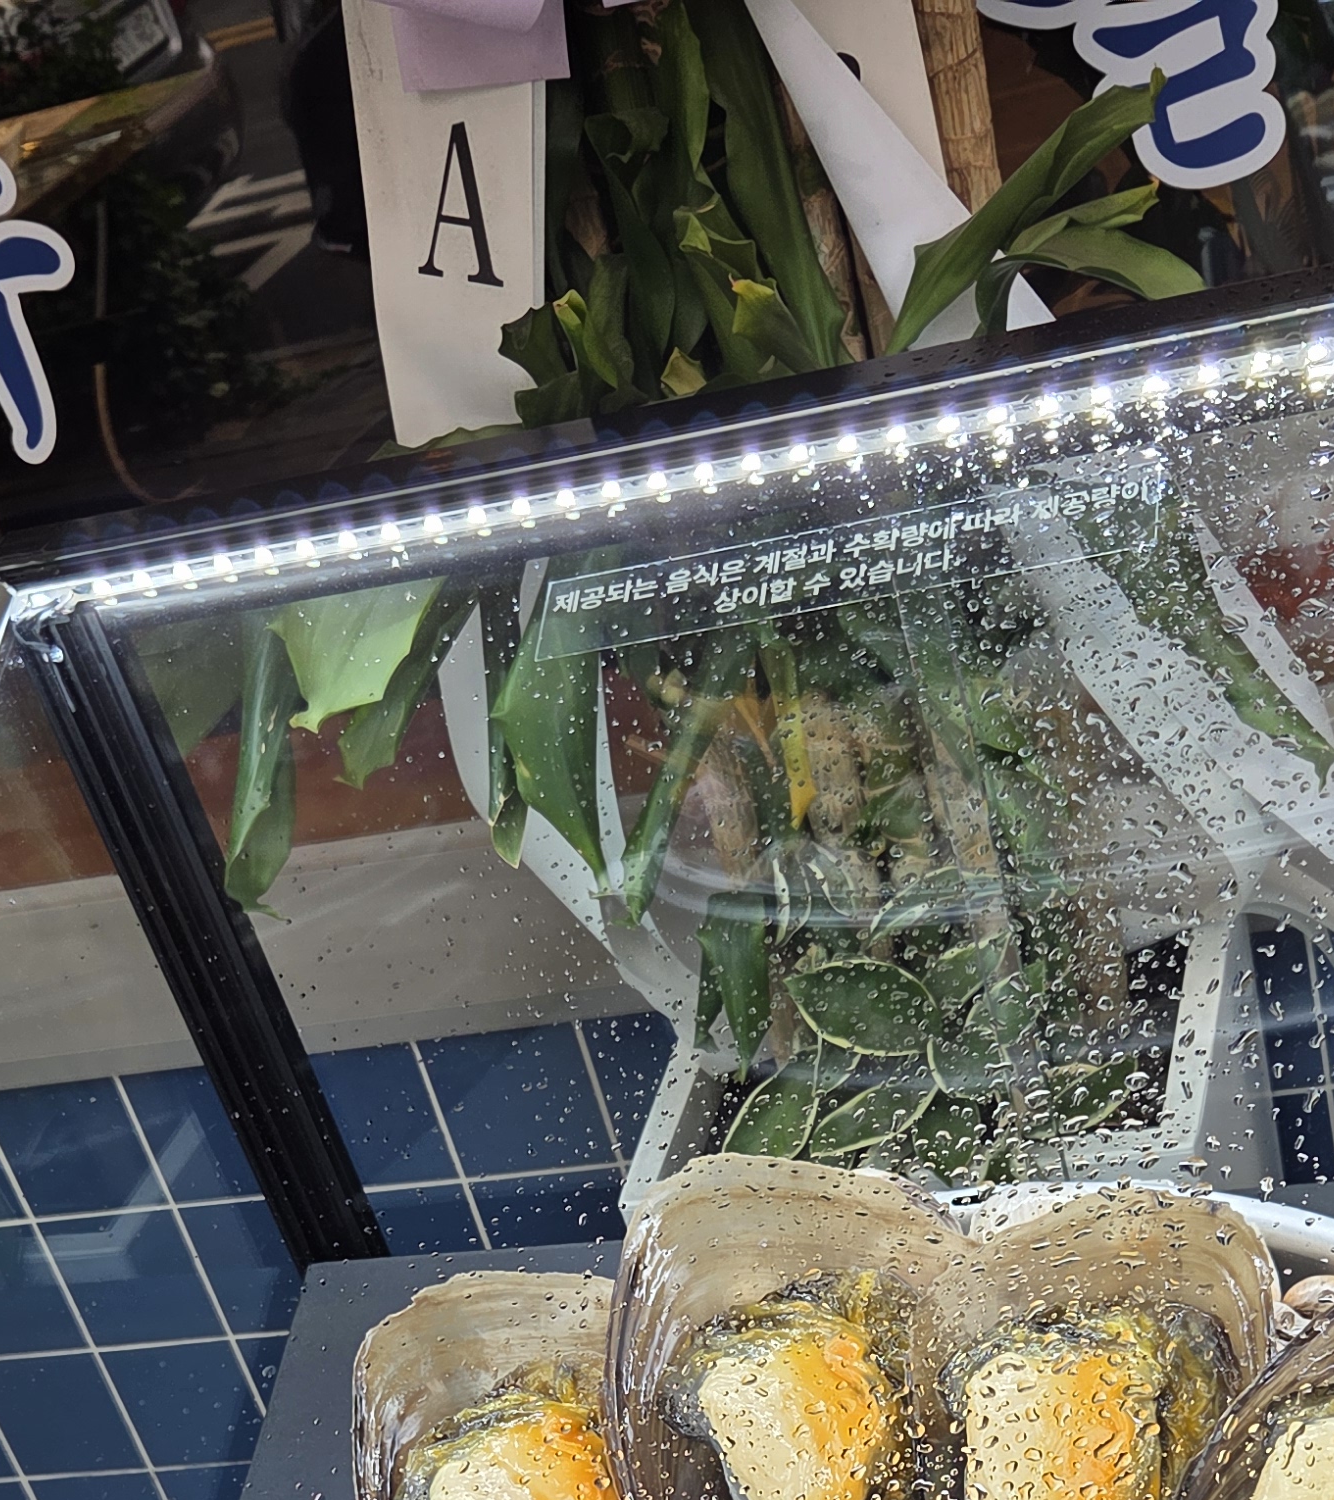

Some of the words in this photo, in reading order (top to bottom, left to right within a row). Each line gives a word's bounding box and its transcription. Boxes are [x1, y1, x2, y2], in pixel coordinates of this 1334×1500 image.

[418, 121, 504, 288] A
[552, 576, 658, 613] 제공되는
[665, 559, 746, 594] 음식은
[753, 538, 837, 574] 계절과
[843, 514, 959, 558] 수확량에
[961, 505, 1023, 533] 따라
[1030, 477, 1149, 519] 제공량이
[714, 576, 797, 613] 상이할
[802, 572, 831, 595] 수
